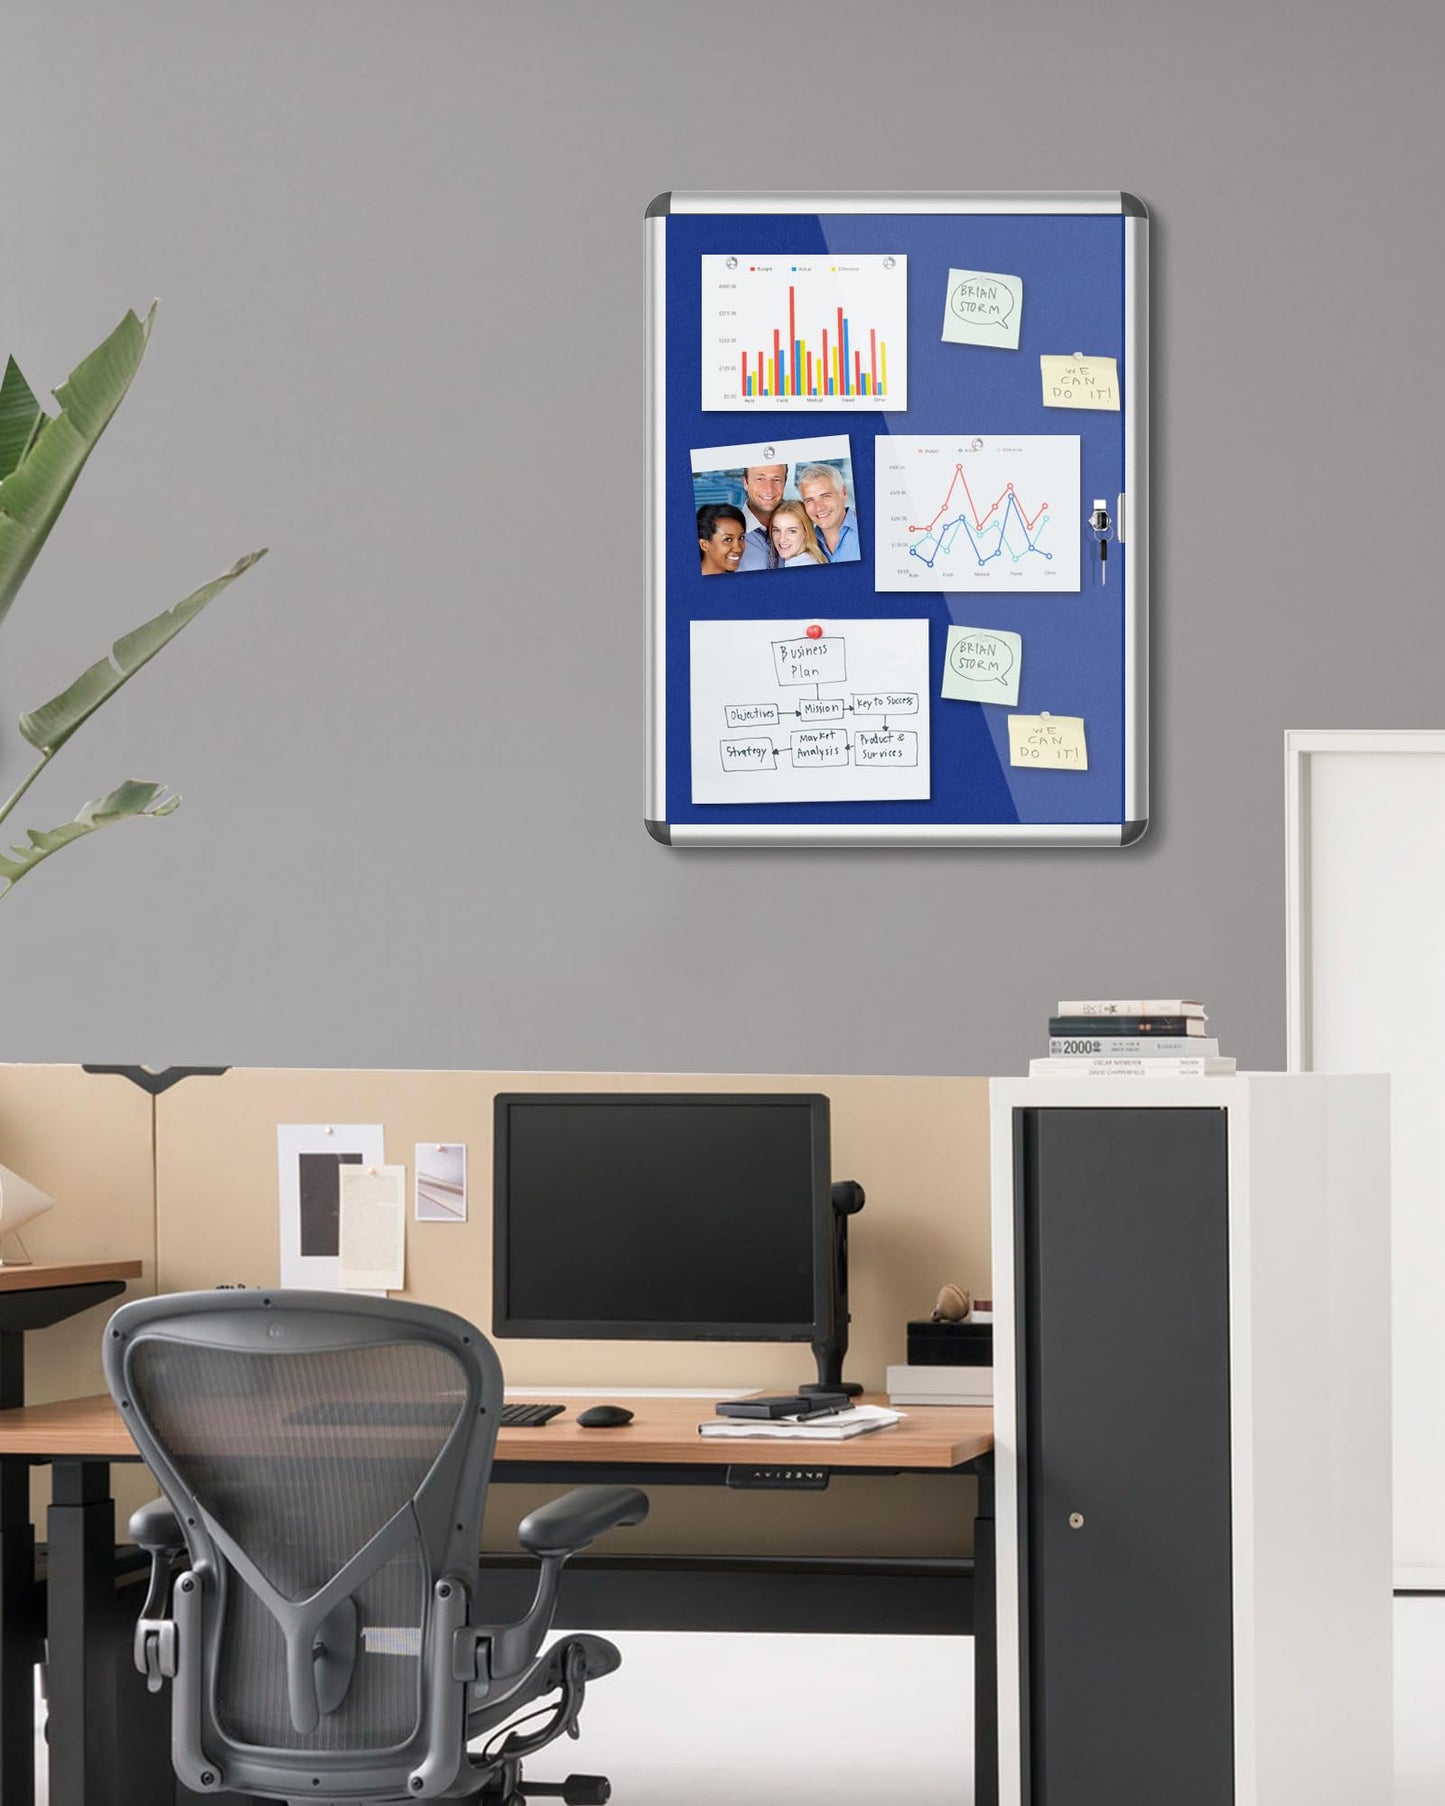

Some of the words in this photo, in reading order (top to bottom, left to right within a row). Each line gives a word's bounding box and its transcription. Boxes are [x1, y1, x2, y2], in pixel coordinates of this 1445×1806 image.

[960, 284, 998, 300] BRIAN
[959, 301, 1000, 315] STORM
[1065, 367, 1090, 376] WE
[1060, 376, 1096, 386] CAN
[1052, 387, 1073, 399] DO
[1090, 387, 1112, 402] IT!
[780, 644, 828, 662] Business
[959, 641, 997, 656] BRIAN
[958, 657, 999, 671] STORM
[791, 665, 820, 679] Plan
[886, 695, 914, 706] Success
[730, 708, 775, 721] Objectives
[804, 703, 839, 714] Mission
[799, 730, 836, 743] Market
[1032, 726, 1057, 735] WE
[860, 731, 894, 746] Product
[1027, 736, 1063, 745] CAN
[726, 746, 767, 763] Strategy
[797, 745, 839, 761] Analysis
[1019, 747, 1040, 759] DO
[1057, 747, 1079, 762] IT!
[1063, 1040, 1093, 1054] 2000
